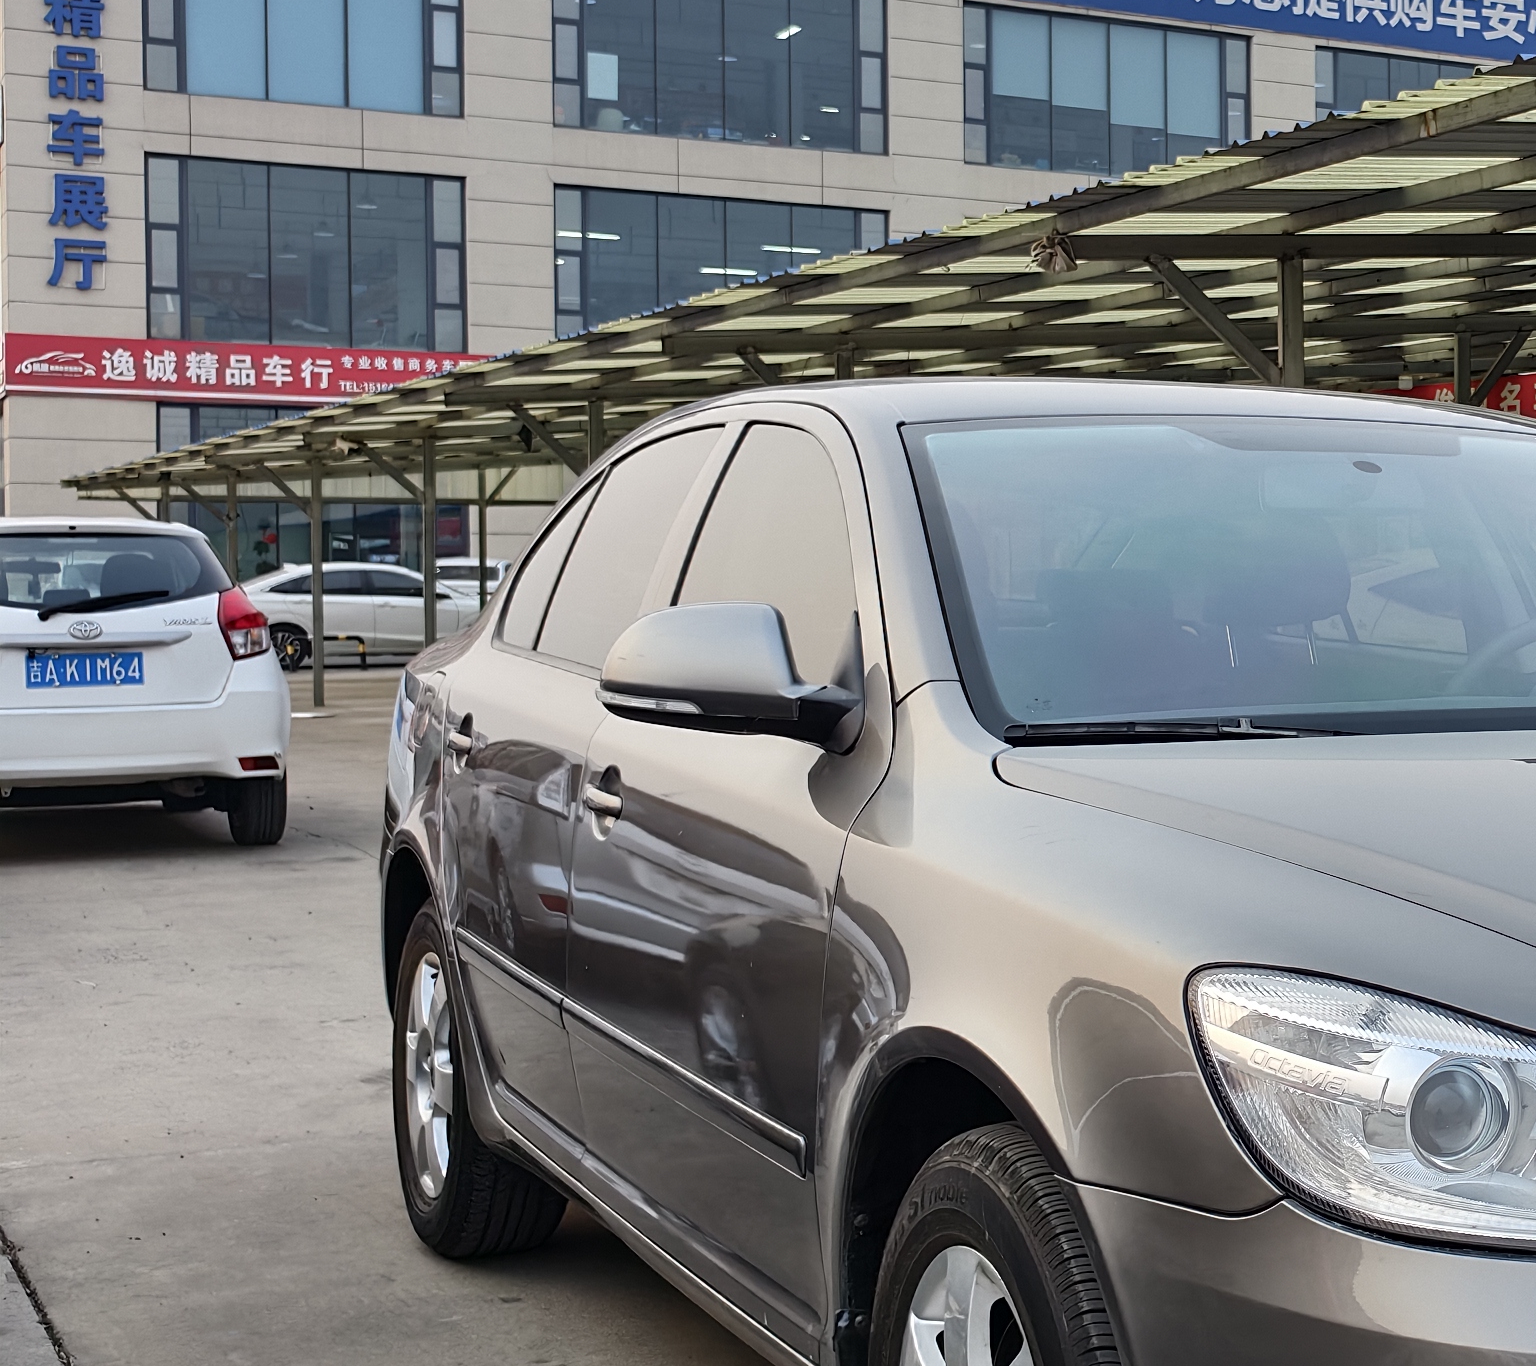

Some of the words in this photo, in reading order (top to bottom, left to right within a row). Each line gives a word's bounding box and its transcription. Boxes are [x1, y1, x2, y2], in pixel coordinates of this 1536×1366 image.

[101, 347, 334, 390] 逸诚精品车行
